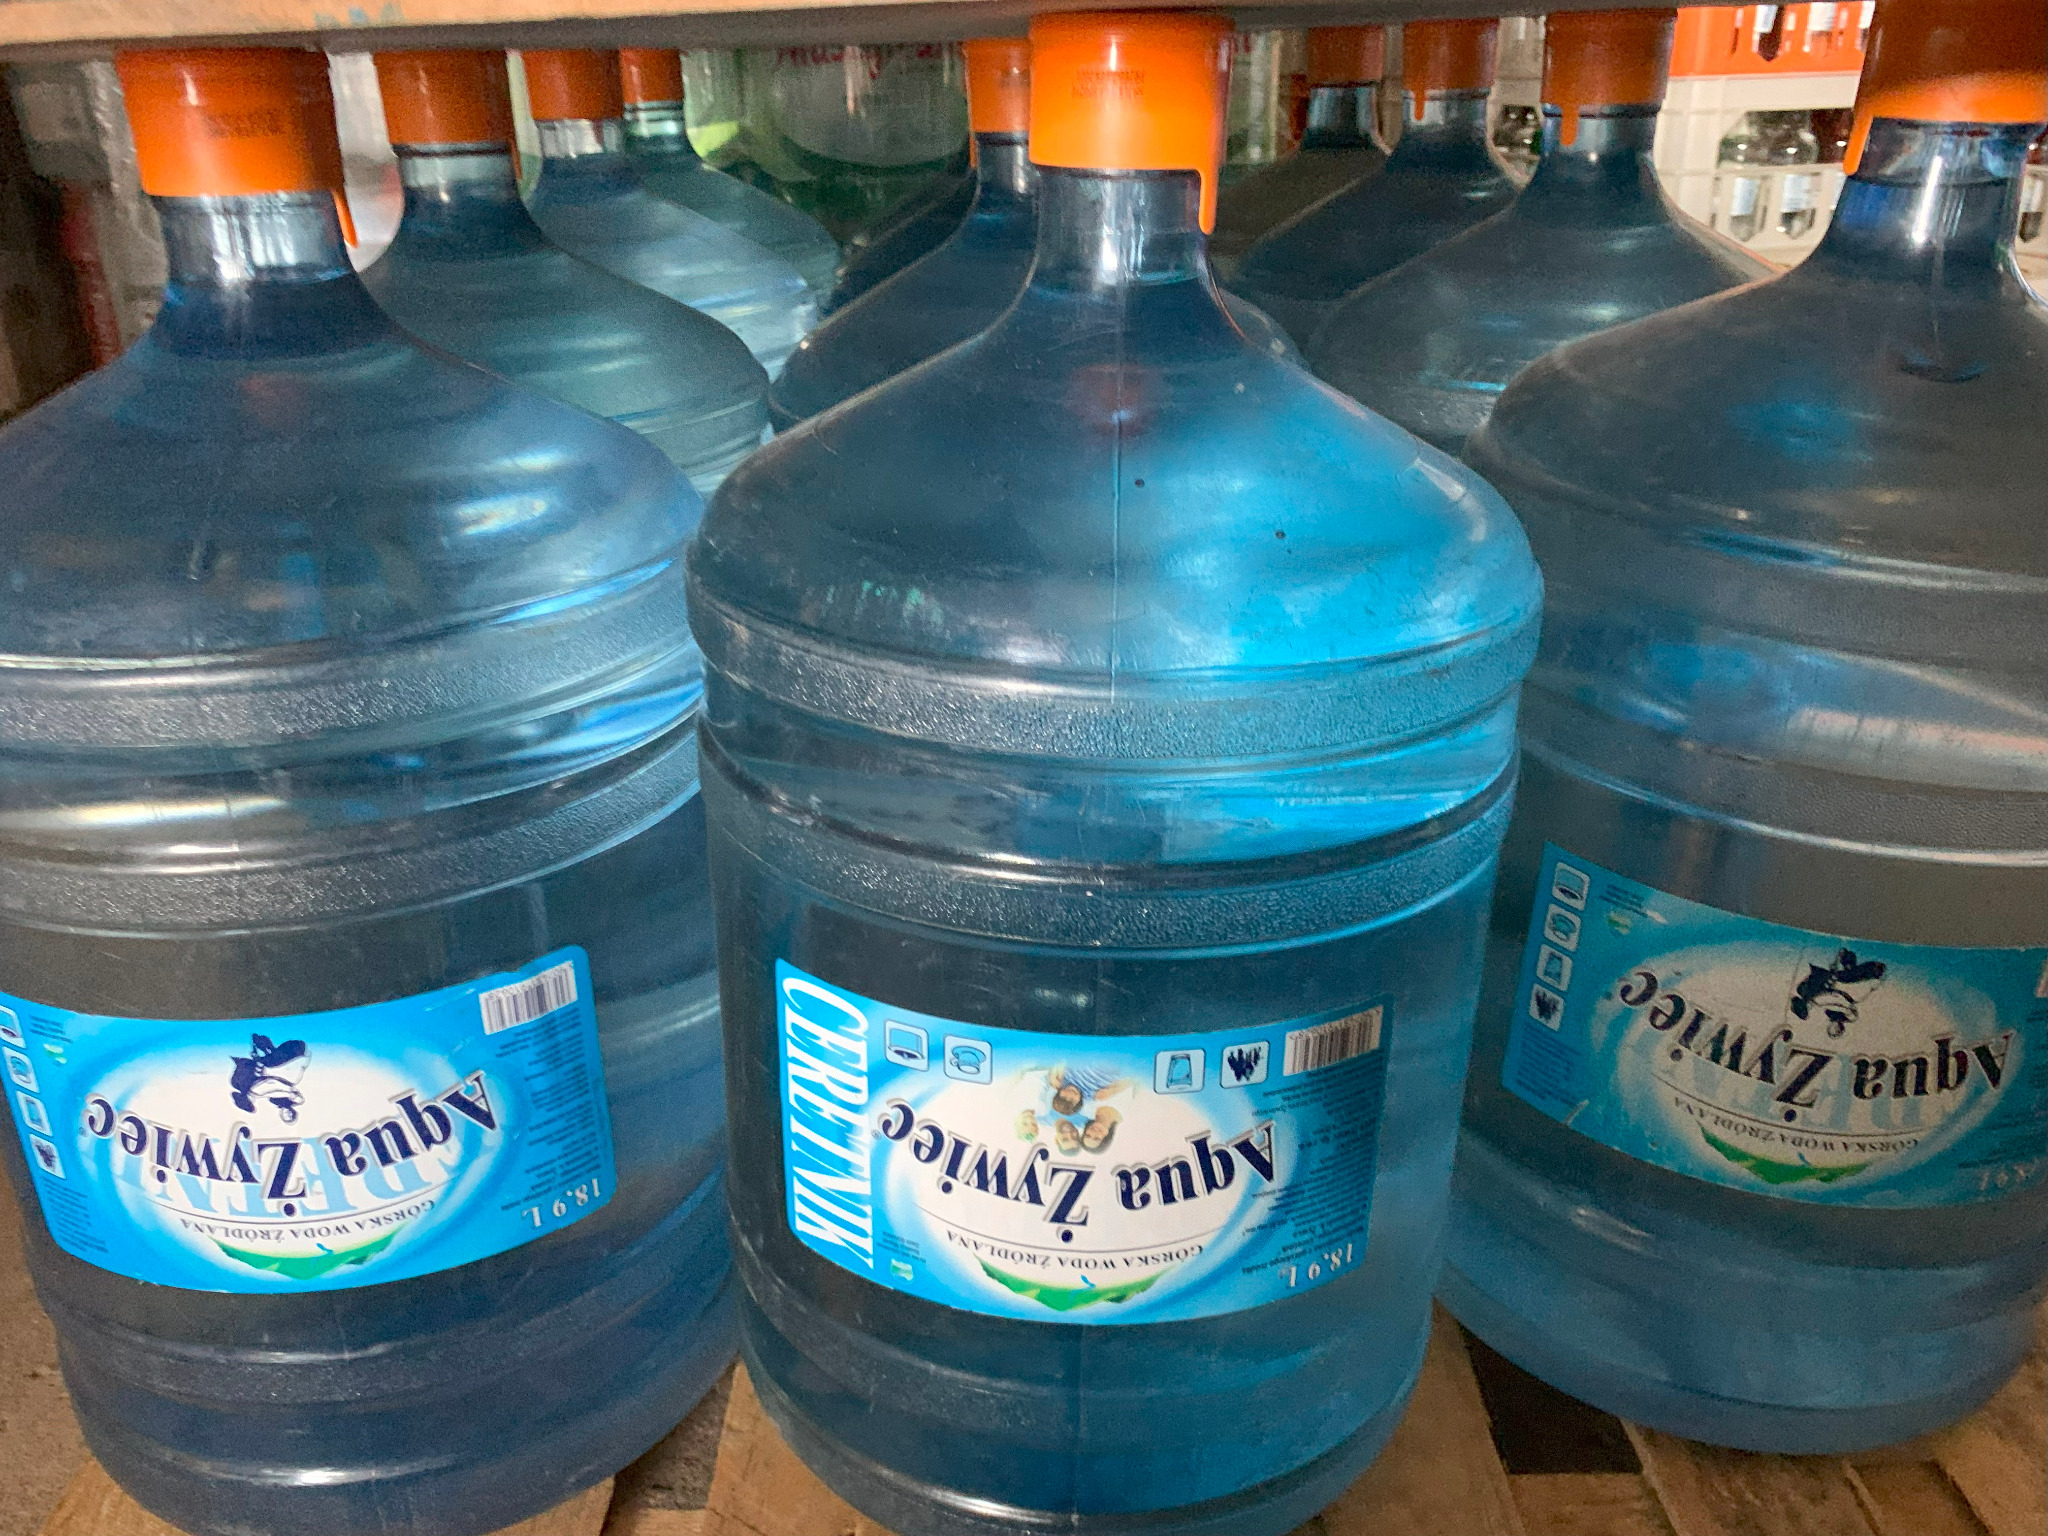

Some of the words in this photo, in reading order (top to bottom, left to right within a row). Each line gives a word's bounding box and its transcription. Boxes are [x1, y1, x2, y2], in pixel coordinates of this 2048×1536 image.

[1617, 968, 1832, 1123] Żywiec
[1852, 1032, 2014, 1101] Aqua
[324, 1073, 498, 1177] Aqua
[780, 975, 874, 1269] CERETNIK
[86, 1097, 306, 1217] Żywiec
[1779, 1133, 1835, 1151] WODA
[1843, 1138, 1918, 1153] GÓRSKA
[877, 1100, 1093, 1244] Żywiec
[1115, 1123, 1277, 1214] Aqua
[354, 1199, 435, 1231] GÓRSKA
[552, 1177, 602, 1215] 18,9
[179, 1217, 284, 1243] ŹRÓDLANA
[290, 1217, 349, 1240] WODA
[522, 1204, 542, 1228] L
[945, 1230, 1050, 1270] ŹRÓDLANA
[1057, 1255, 1116, 1271] WODA
[1123, 1244, 1204, 1267] GÓRSKA
